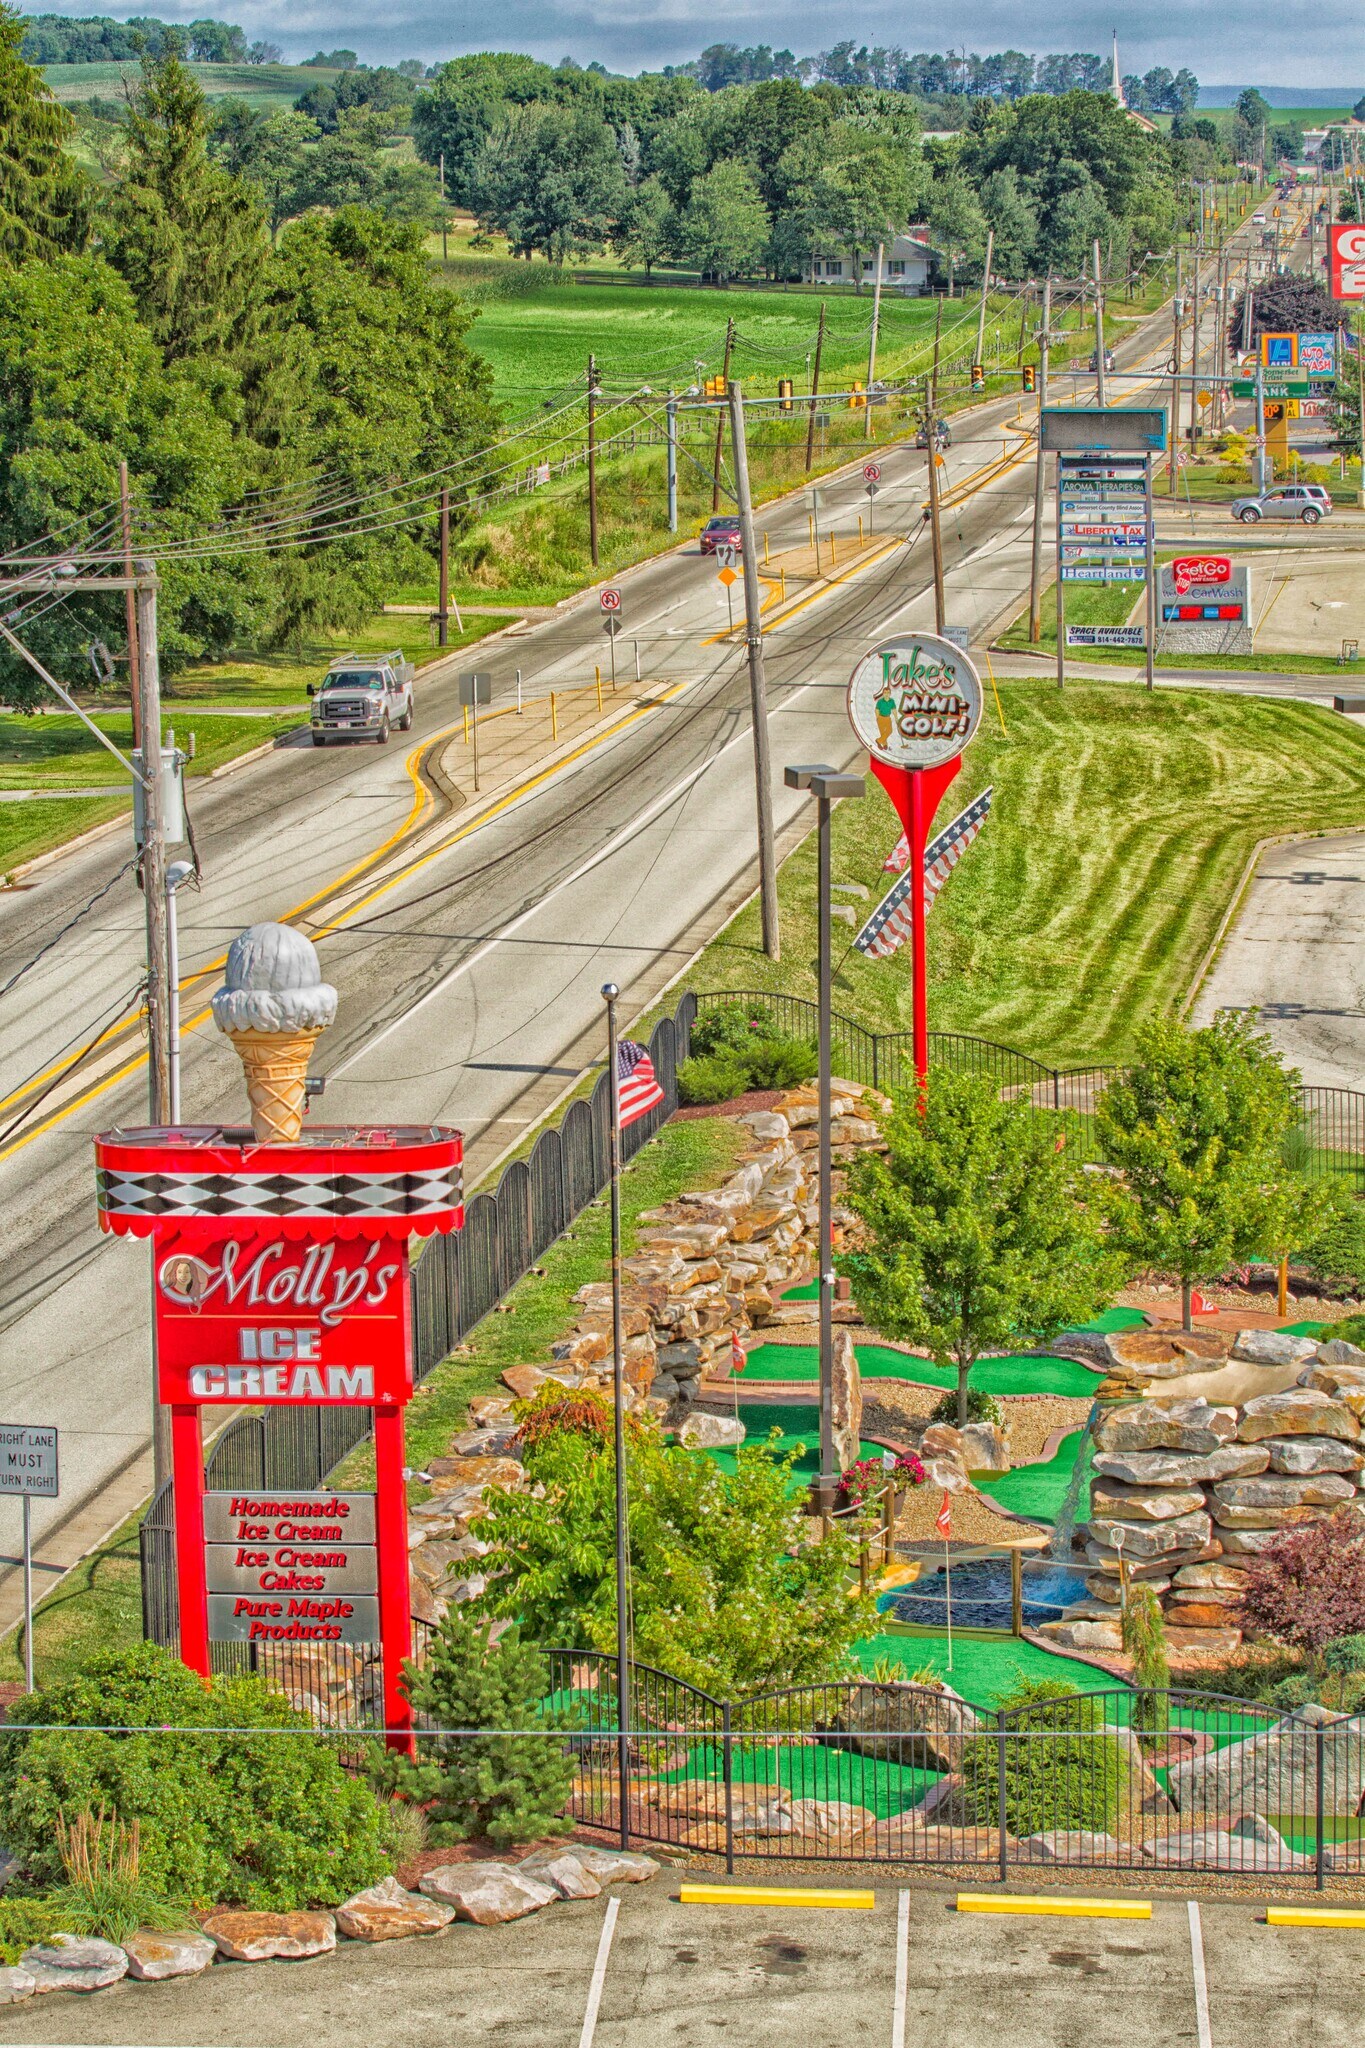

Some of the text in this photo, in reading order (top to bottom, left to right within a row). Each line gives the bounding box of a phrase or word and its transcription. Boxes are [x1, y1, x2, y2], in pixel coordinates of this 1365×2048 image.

[1301, 348, 1323, 358] AUTO
[1301, 360, 1331, 371] WASH
[1063, 482, 1094, 491] AROMA
[1095, 482, 1134, 491] THERAPIES
[1074, 524, 1142, 534] LIBERTY TAX
[1065, 567, 1132, 579] Heartland
[1176, 561, 1227, 576] GetGo
[1176, 578, 1190, 588] STOP
[1191, 588, 1243, 599] CarWash
[1098, 627, 1142, 635] AVAILABLE
[873, 645, 955, 700] Jake's
[902, 694, 970, 714] MINI-
[901, 712, 969, 737] GOLF!
[205, 1240, 400, 1327] Molly's
[240, 1327, 321, 1360] ICE
[189, 1364, 375, 1399] CREAM
[28, 1435, 54, 1447] LANE
[8, 1453, 43, 1468] MUST
[26, 1476, 55, 1487] RIGHT
[229, 1497, 350, 1517] Homemade
[237, 1521, 342, 1540] Ice Cream
[234, 1548, 346, 1567] Ice Cream
[259, 1570, 325, 1590] Cakes
[233, 1598, 353, 1621] Pure Maple
[248, 1620, 342, 1640] Products
